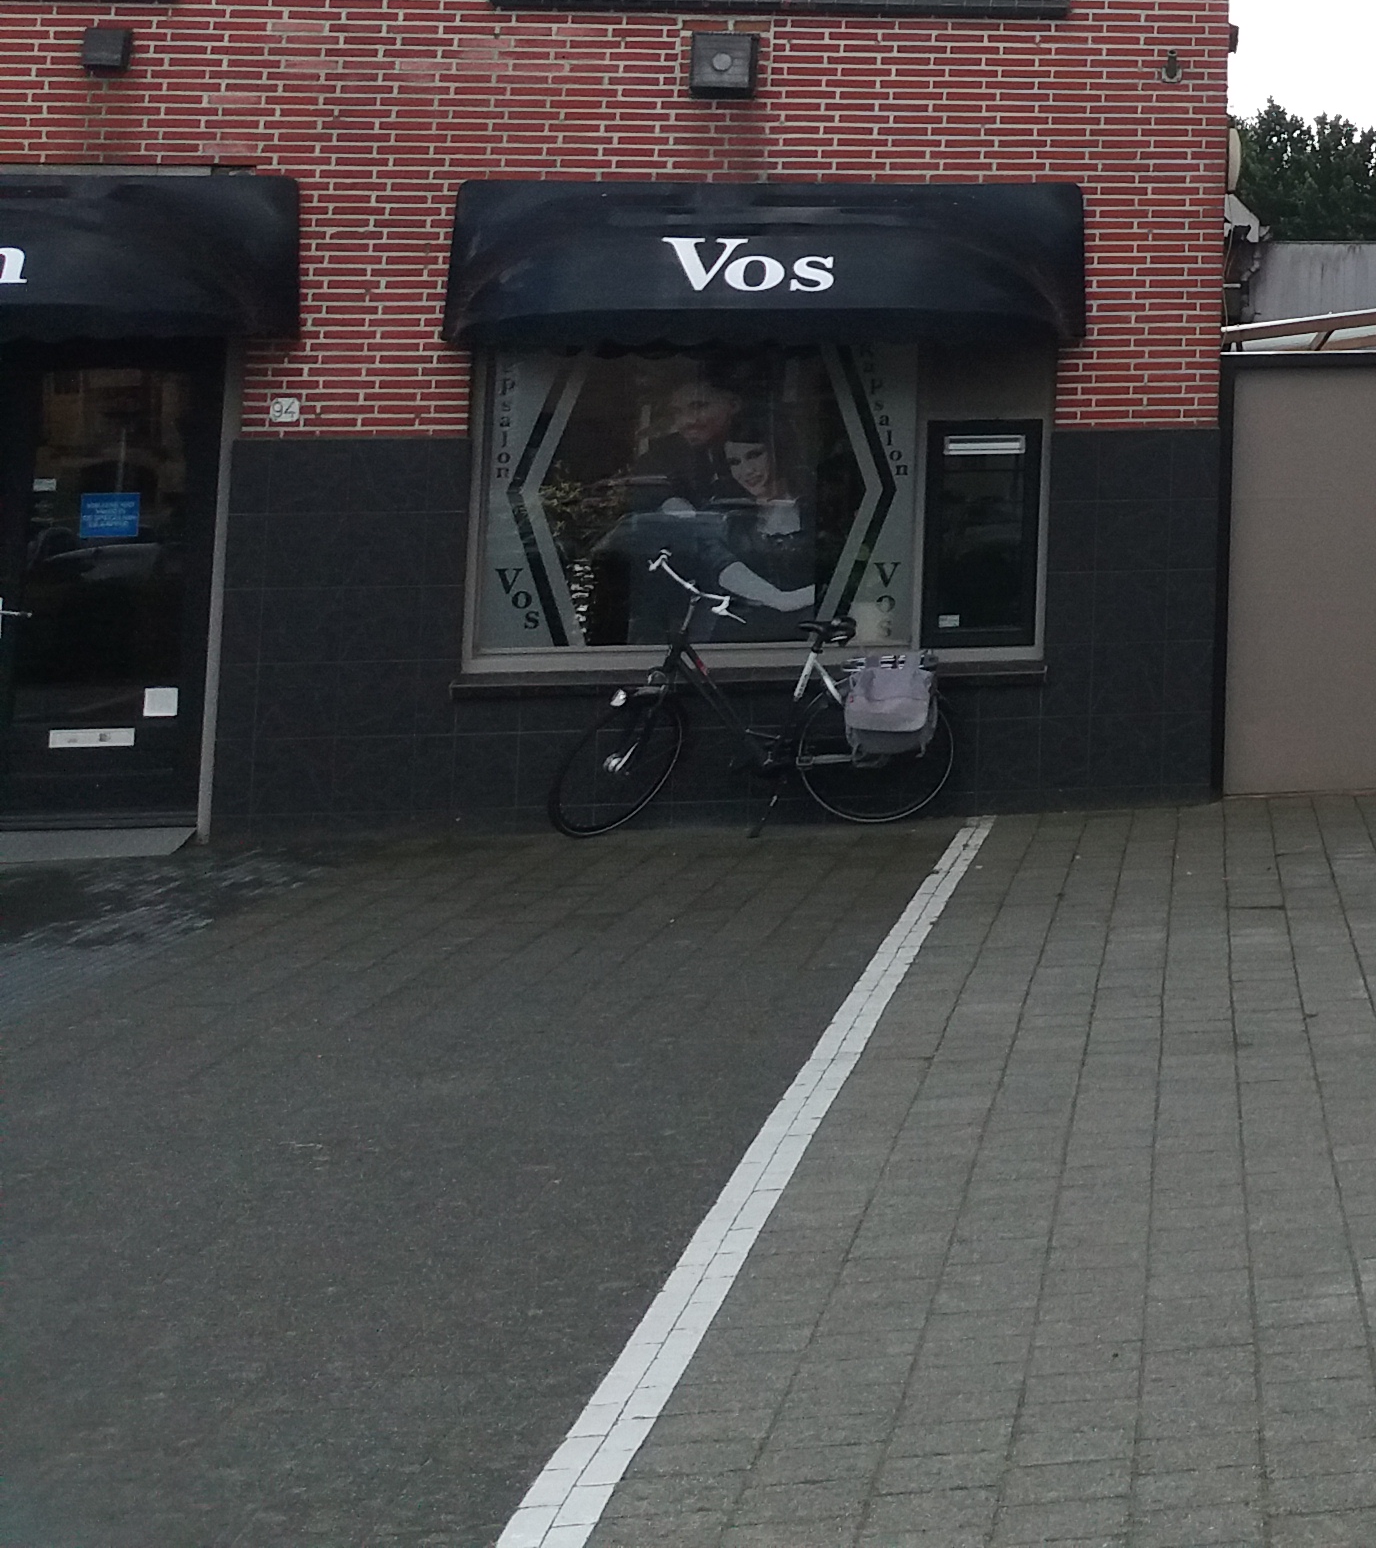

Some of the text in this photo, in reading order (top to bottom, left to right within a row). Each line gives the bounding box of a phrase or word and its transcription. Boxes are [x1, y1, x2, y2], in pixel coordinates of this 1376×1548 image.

[661, 236, 835, 292] Vos
[272, 398, 297, 419] 94
[496, 367, 516, 479] psalon
[495, 567, 541, 630] Vos
